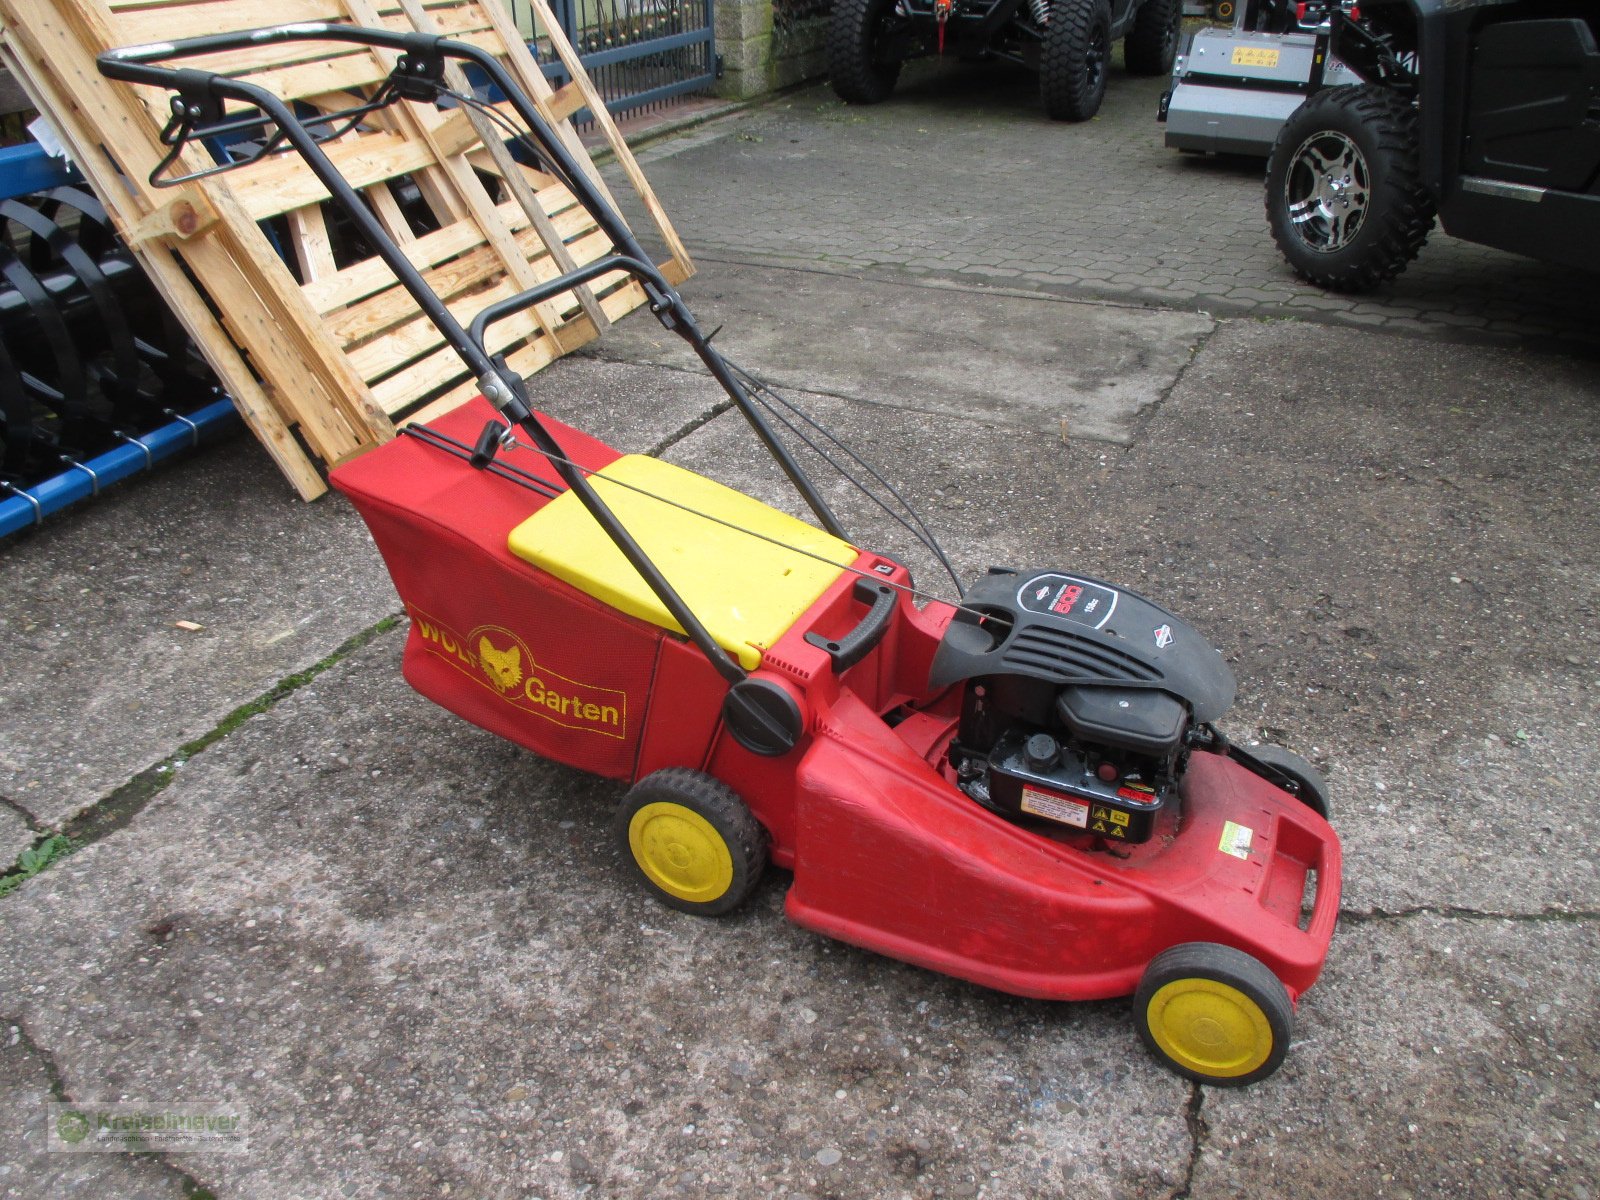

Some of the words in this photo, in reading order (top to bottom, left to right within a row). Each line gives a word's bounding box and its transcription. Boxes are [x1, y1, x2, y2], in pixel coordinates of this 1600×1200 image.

[1053, 584, 1083, 614] 500
[415, 616, 477, 669] WOLF
[524, 676, 619, 726] Garten
